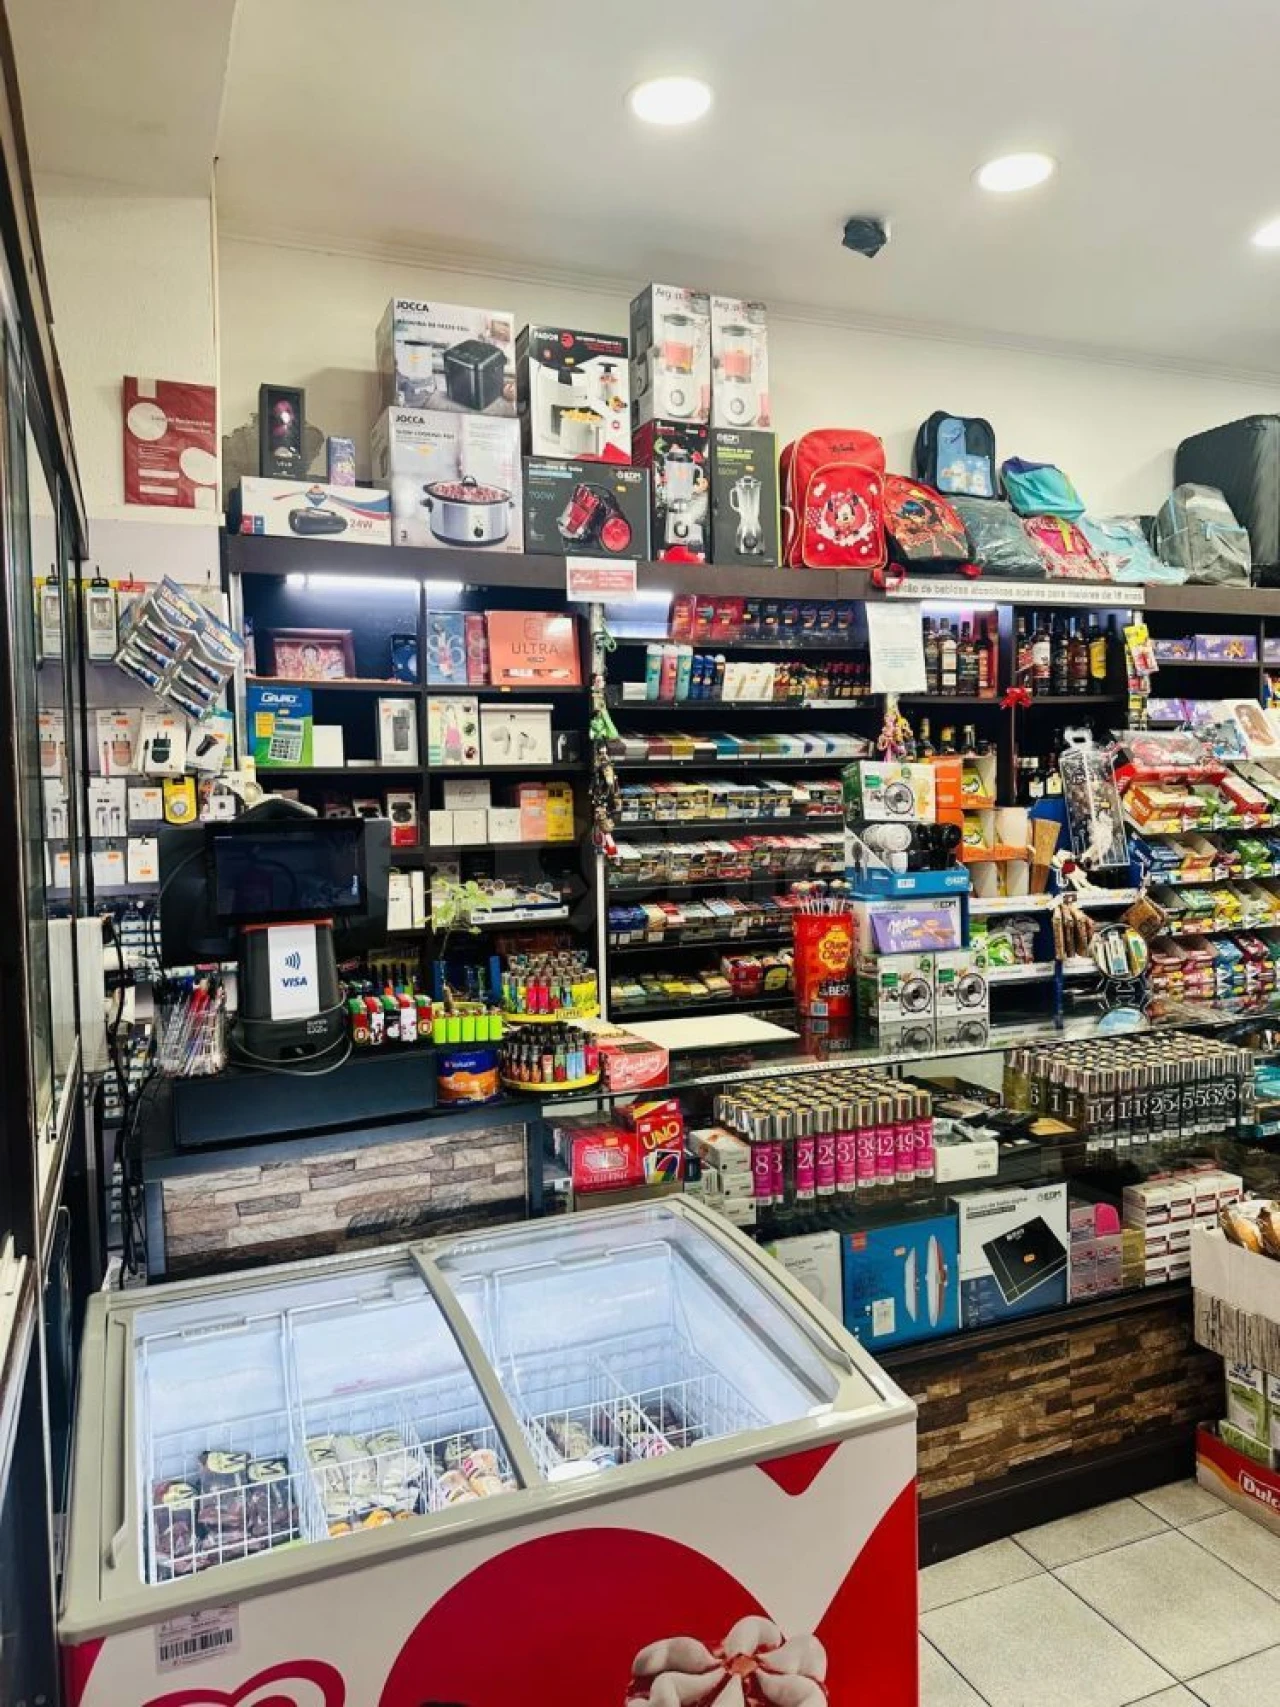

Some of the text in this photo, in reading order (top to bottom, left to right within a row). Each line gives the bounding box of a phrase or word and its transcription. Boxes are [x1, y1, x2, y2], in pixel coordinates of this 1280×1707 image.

[396, 300, 429, 312] JOCCA
[395, 413, 426, 424] JOCCA
[511, 641, 559, 655] ULTRA
[281, 976, 307, 987] VISA
[642, 1120, 681, 1150] UNO
